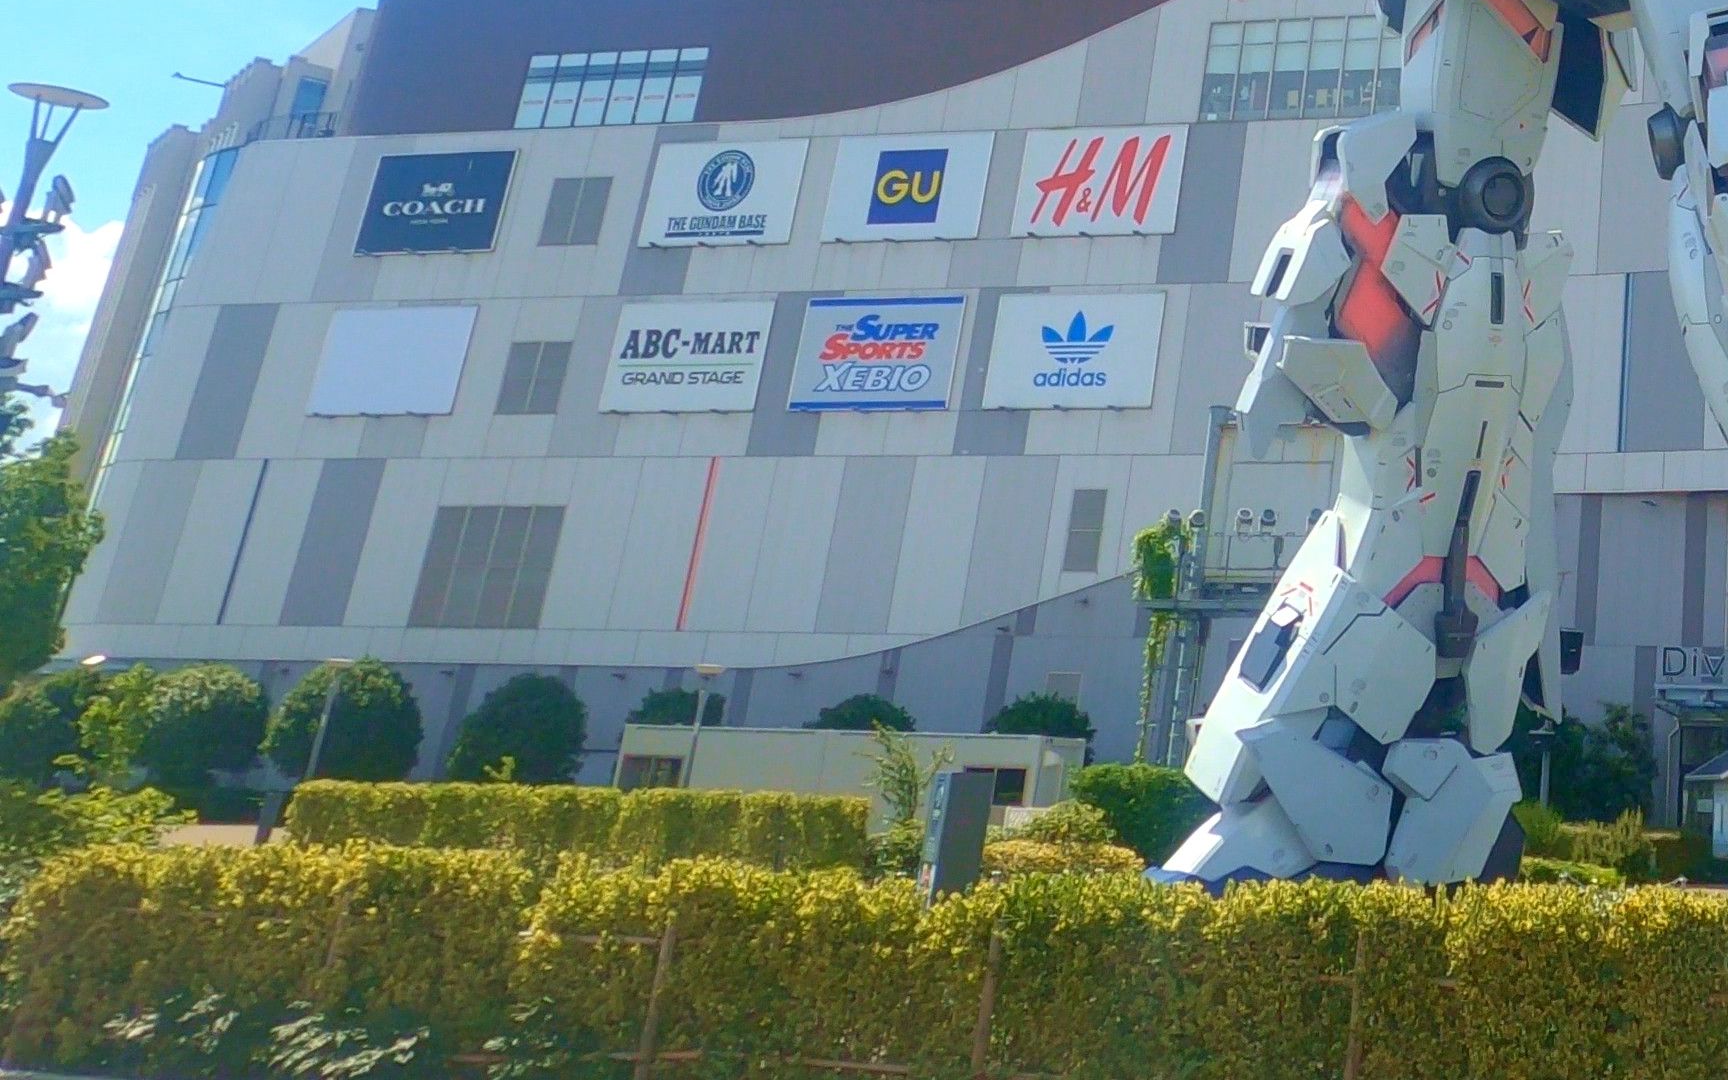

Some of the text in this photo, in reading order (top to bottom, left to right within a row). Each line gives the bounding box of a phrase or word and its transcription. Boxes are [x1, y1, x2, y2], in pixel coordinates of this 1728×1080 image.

[876, 169, 943, 206] GU
[1030, 134, 1172, 227] H&M
[382, 197, 486, 217] COACH
[667, 214, 767, 231] THE GUNDAM BASE
[850, 314, 939, 341] SUPER
[619, 328, 760, 360] ABC-MART
[819, 333, 926, 360] SPORTS
[621, 370, 745, 386] GRAND STAGE
[812, 361, 932, 392] XEBIO
[1033, 366, 1107, 388] adidas
